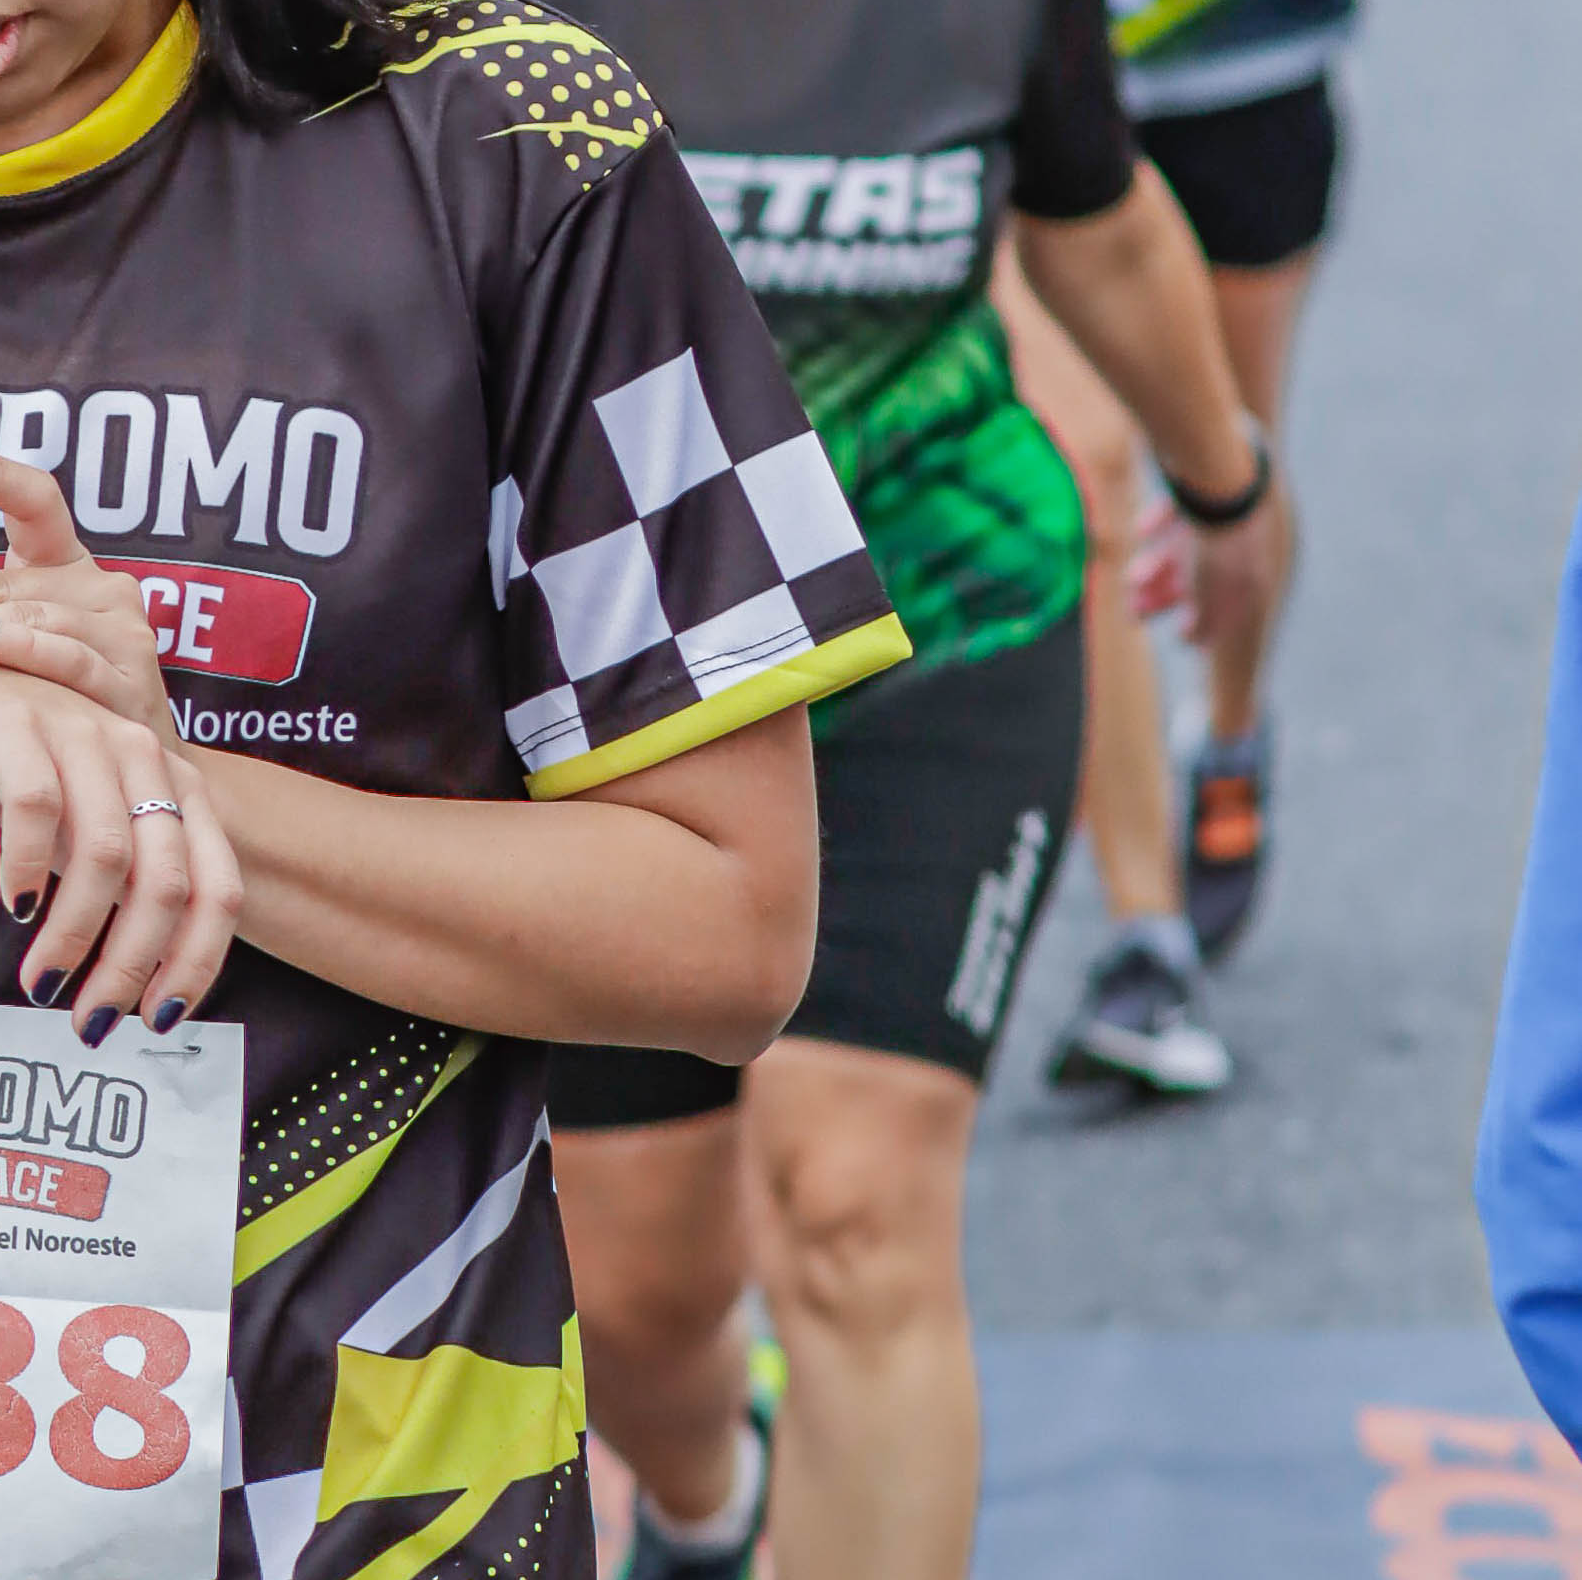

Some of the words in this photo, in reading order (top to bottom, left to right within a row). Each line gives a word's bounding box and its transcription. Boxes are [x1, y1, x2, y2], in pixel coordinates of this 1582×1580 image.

[680, 146, 984, 237] ETAS
[139, 576, 225, 663] CE
[168, 697, 358, 743] Noroeste
[25, 1228, 137, 1258] Noroeste
